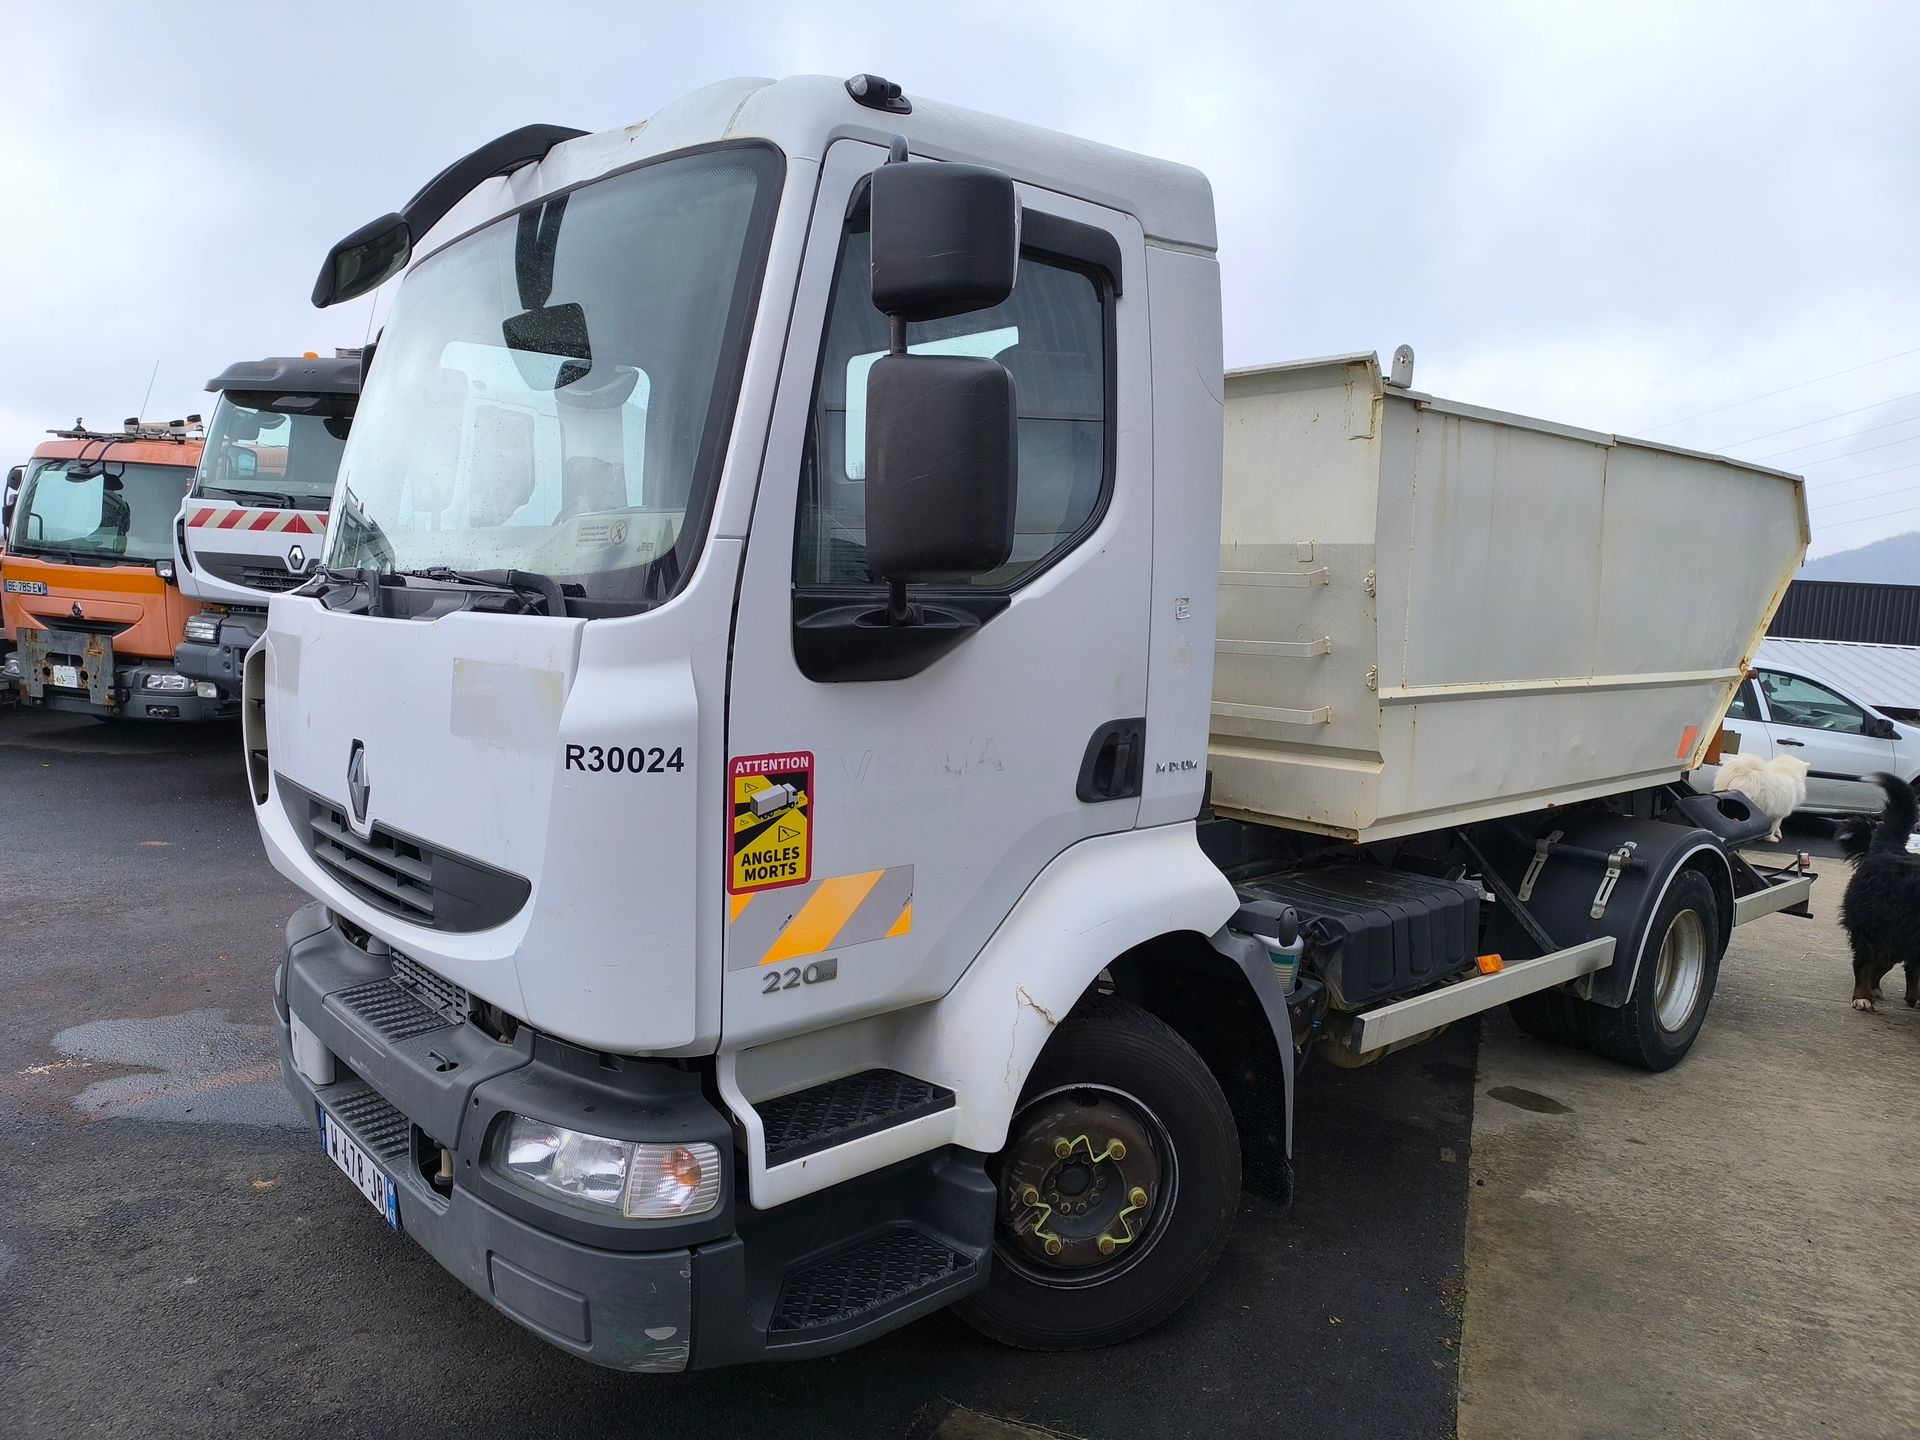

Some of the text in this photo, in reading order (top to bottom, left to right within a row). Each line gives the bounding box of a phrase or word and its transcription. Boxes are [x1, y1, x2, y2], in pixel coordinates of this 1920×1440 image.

[565, 744, 685, 773] R30024
[735, 756, 809, 774] ATTENTION
[741, 846, 801, 867] ANGLES
[744, 861, 797, 882] MORTS
[762, 963, 819, 995] 220
